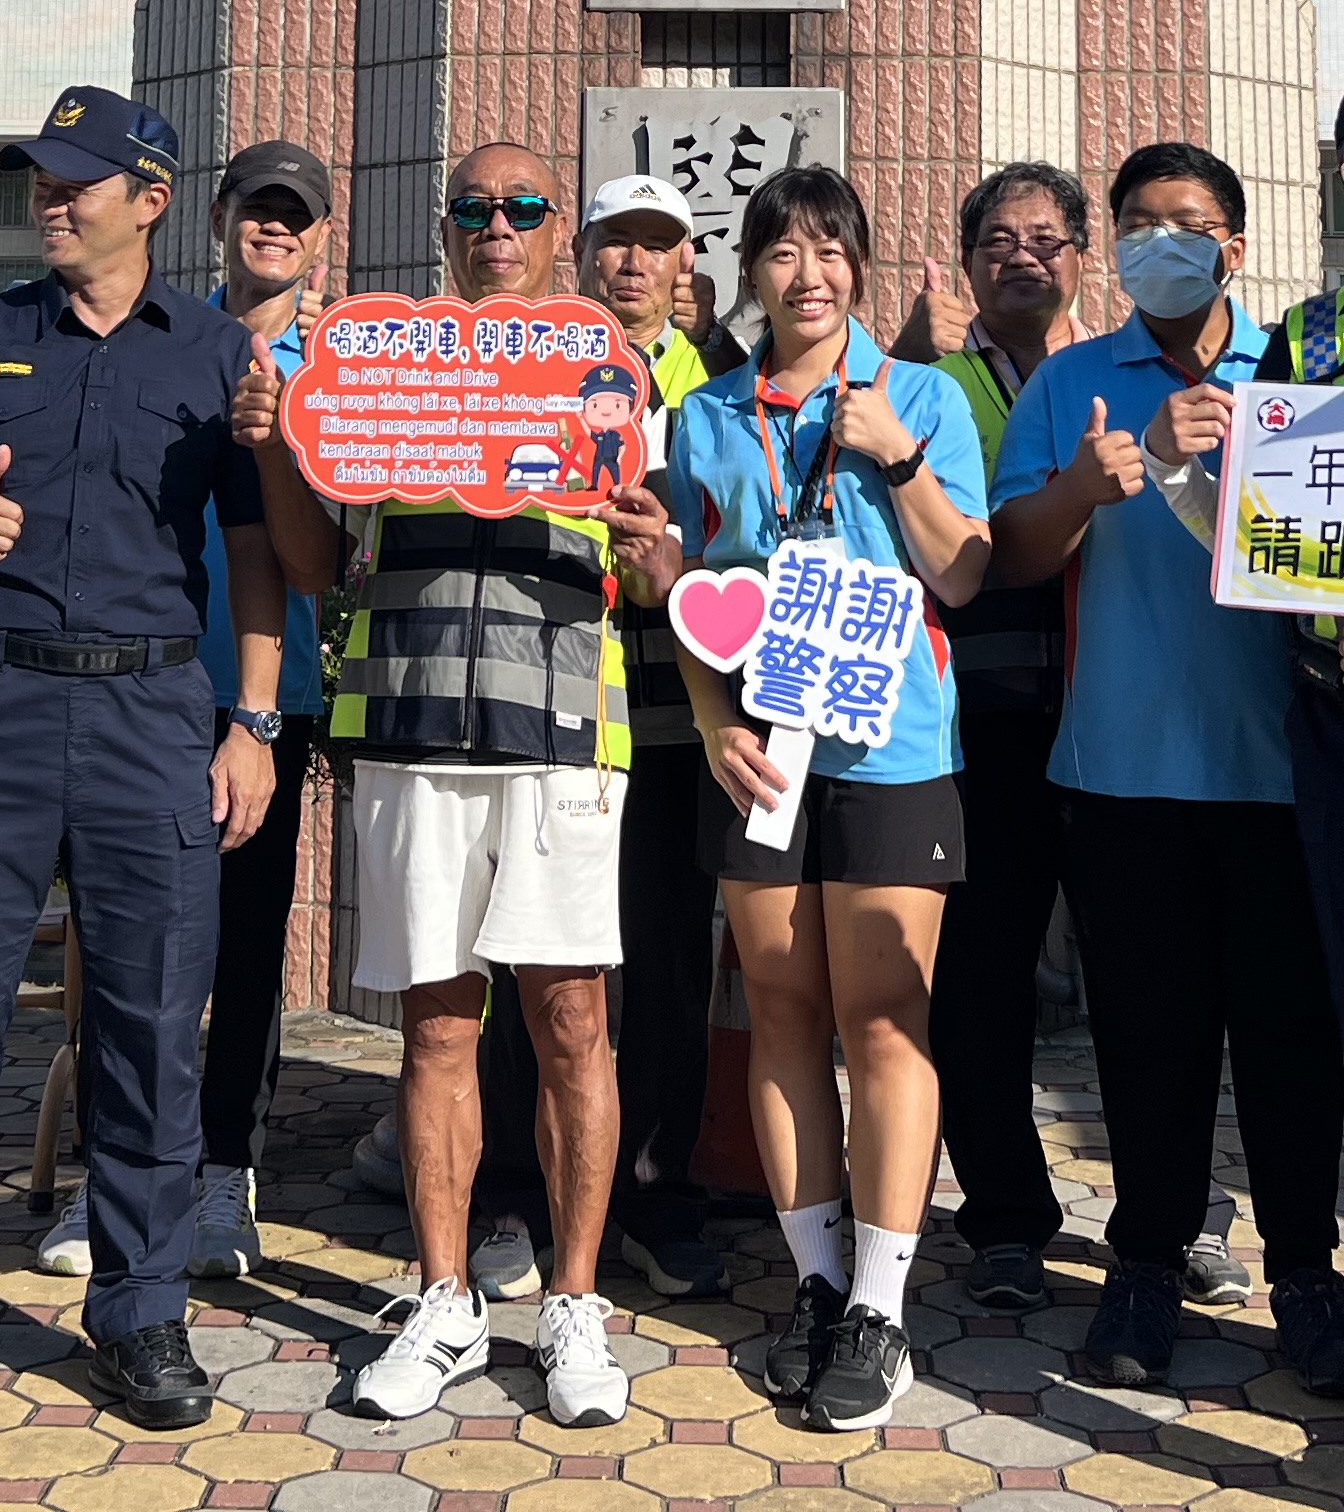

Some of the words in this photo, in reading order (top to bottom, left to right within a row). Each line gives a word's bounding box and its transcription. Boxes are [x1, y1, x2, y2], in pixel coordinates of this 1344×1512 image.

[339, 368, 357, 384] Do
[362, 368, 393, 384] NOT
[397, 368, 430, 384] Drink
[435, 368, 459, 384] and
[464, 369, 498, 385] Drive
[305, 389, 337, 411] uống
[379, 392, 419, 413] không
[422, 392, 438, 409] lái
[441, 397, 461, 412] xe,
[464, 393, 480, 409] lái
[483, 398, 500, 409] xe
[503, 393, 544, 415] không
[320, 417, 376, 437] Dilarang
[380, 417, 457, 437] mengemudi
[460, 418, 485, 434] dan
[488, 419, 557, 435] membawa
[319, 440, 389, 457] kendaraan
[393, 441, 433, 458] disaat
[436, 442, 482, 458] mabuk
[769, 550, 913, 651] 謝謝
[753, 629, 894, 736] 警察
